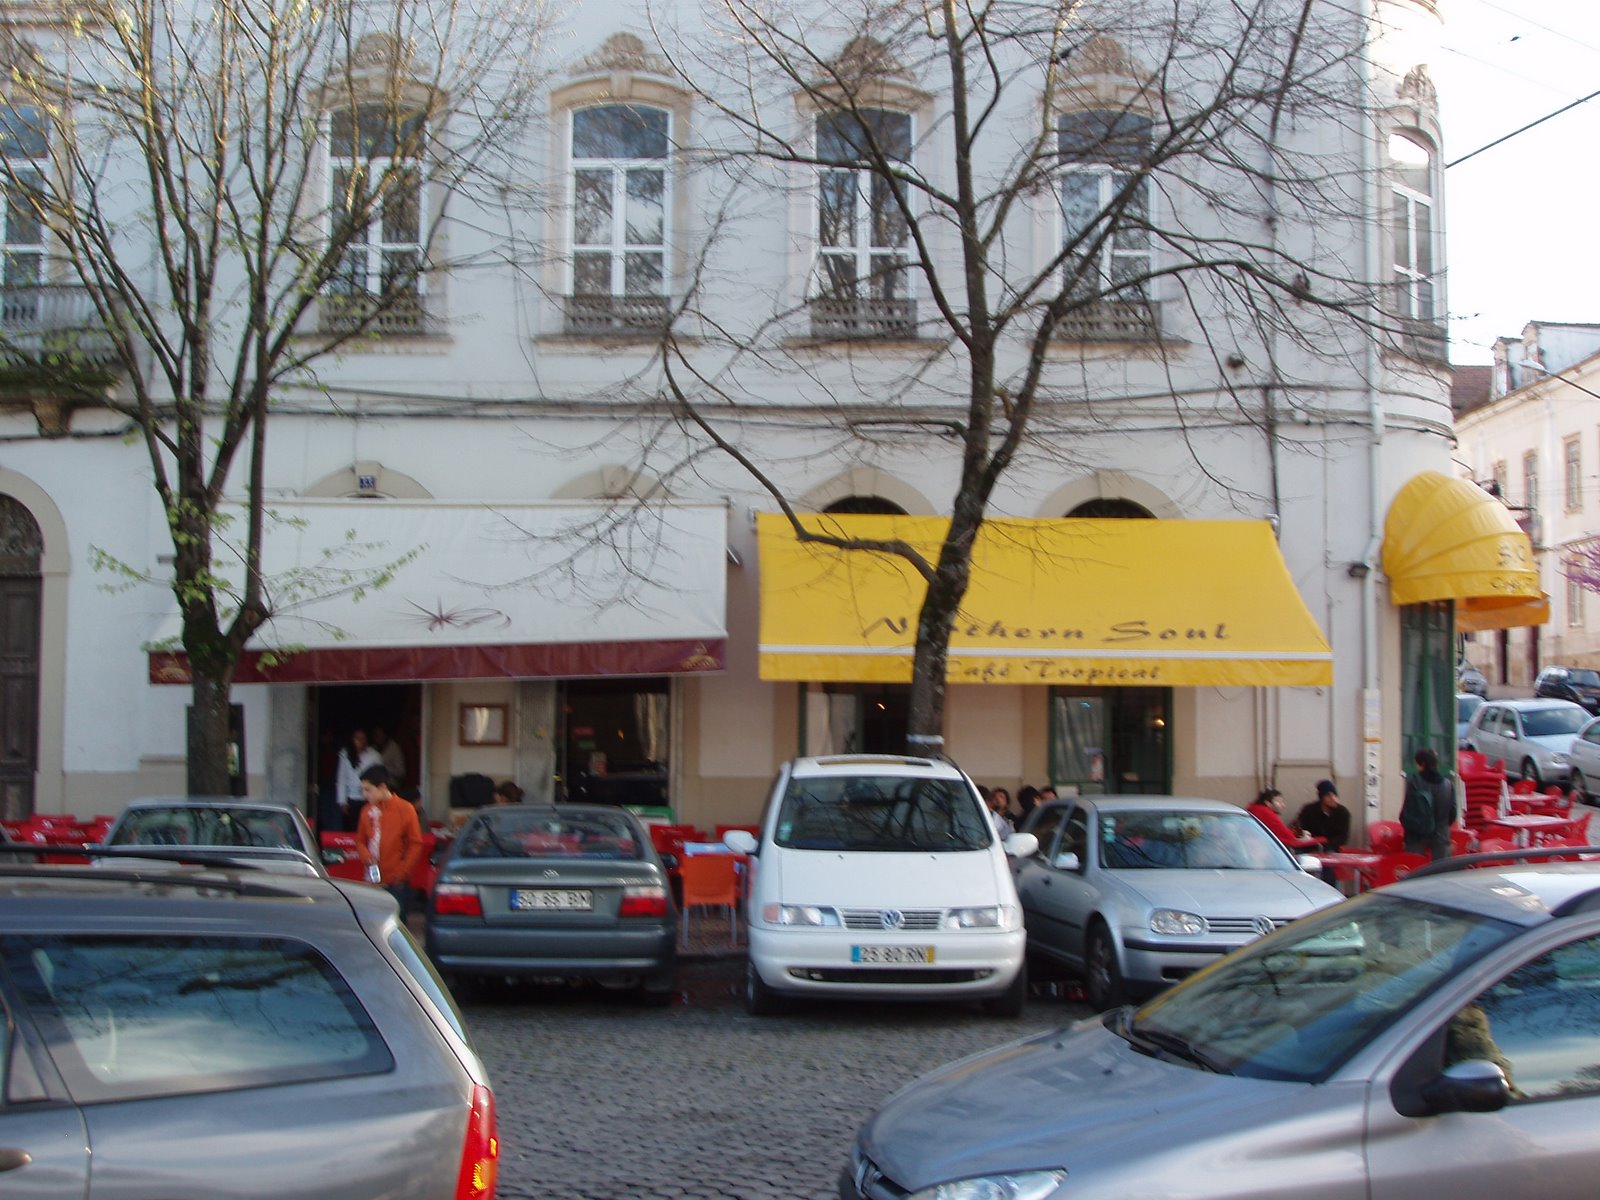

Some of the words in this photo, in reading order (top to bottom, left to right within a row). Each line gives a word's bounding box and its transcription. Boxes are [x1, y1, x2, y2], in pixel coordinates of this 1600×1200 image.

[862, 615, 1084, 640] Nthern
[1101, 620, 1231, 643] Soul
[1024, 657, 1161, 685] Tropical
